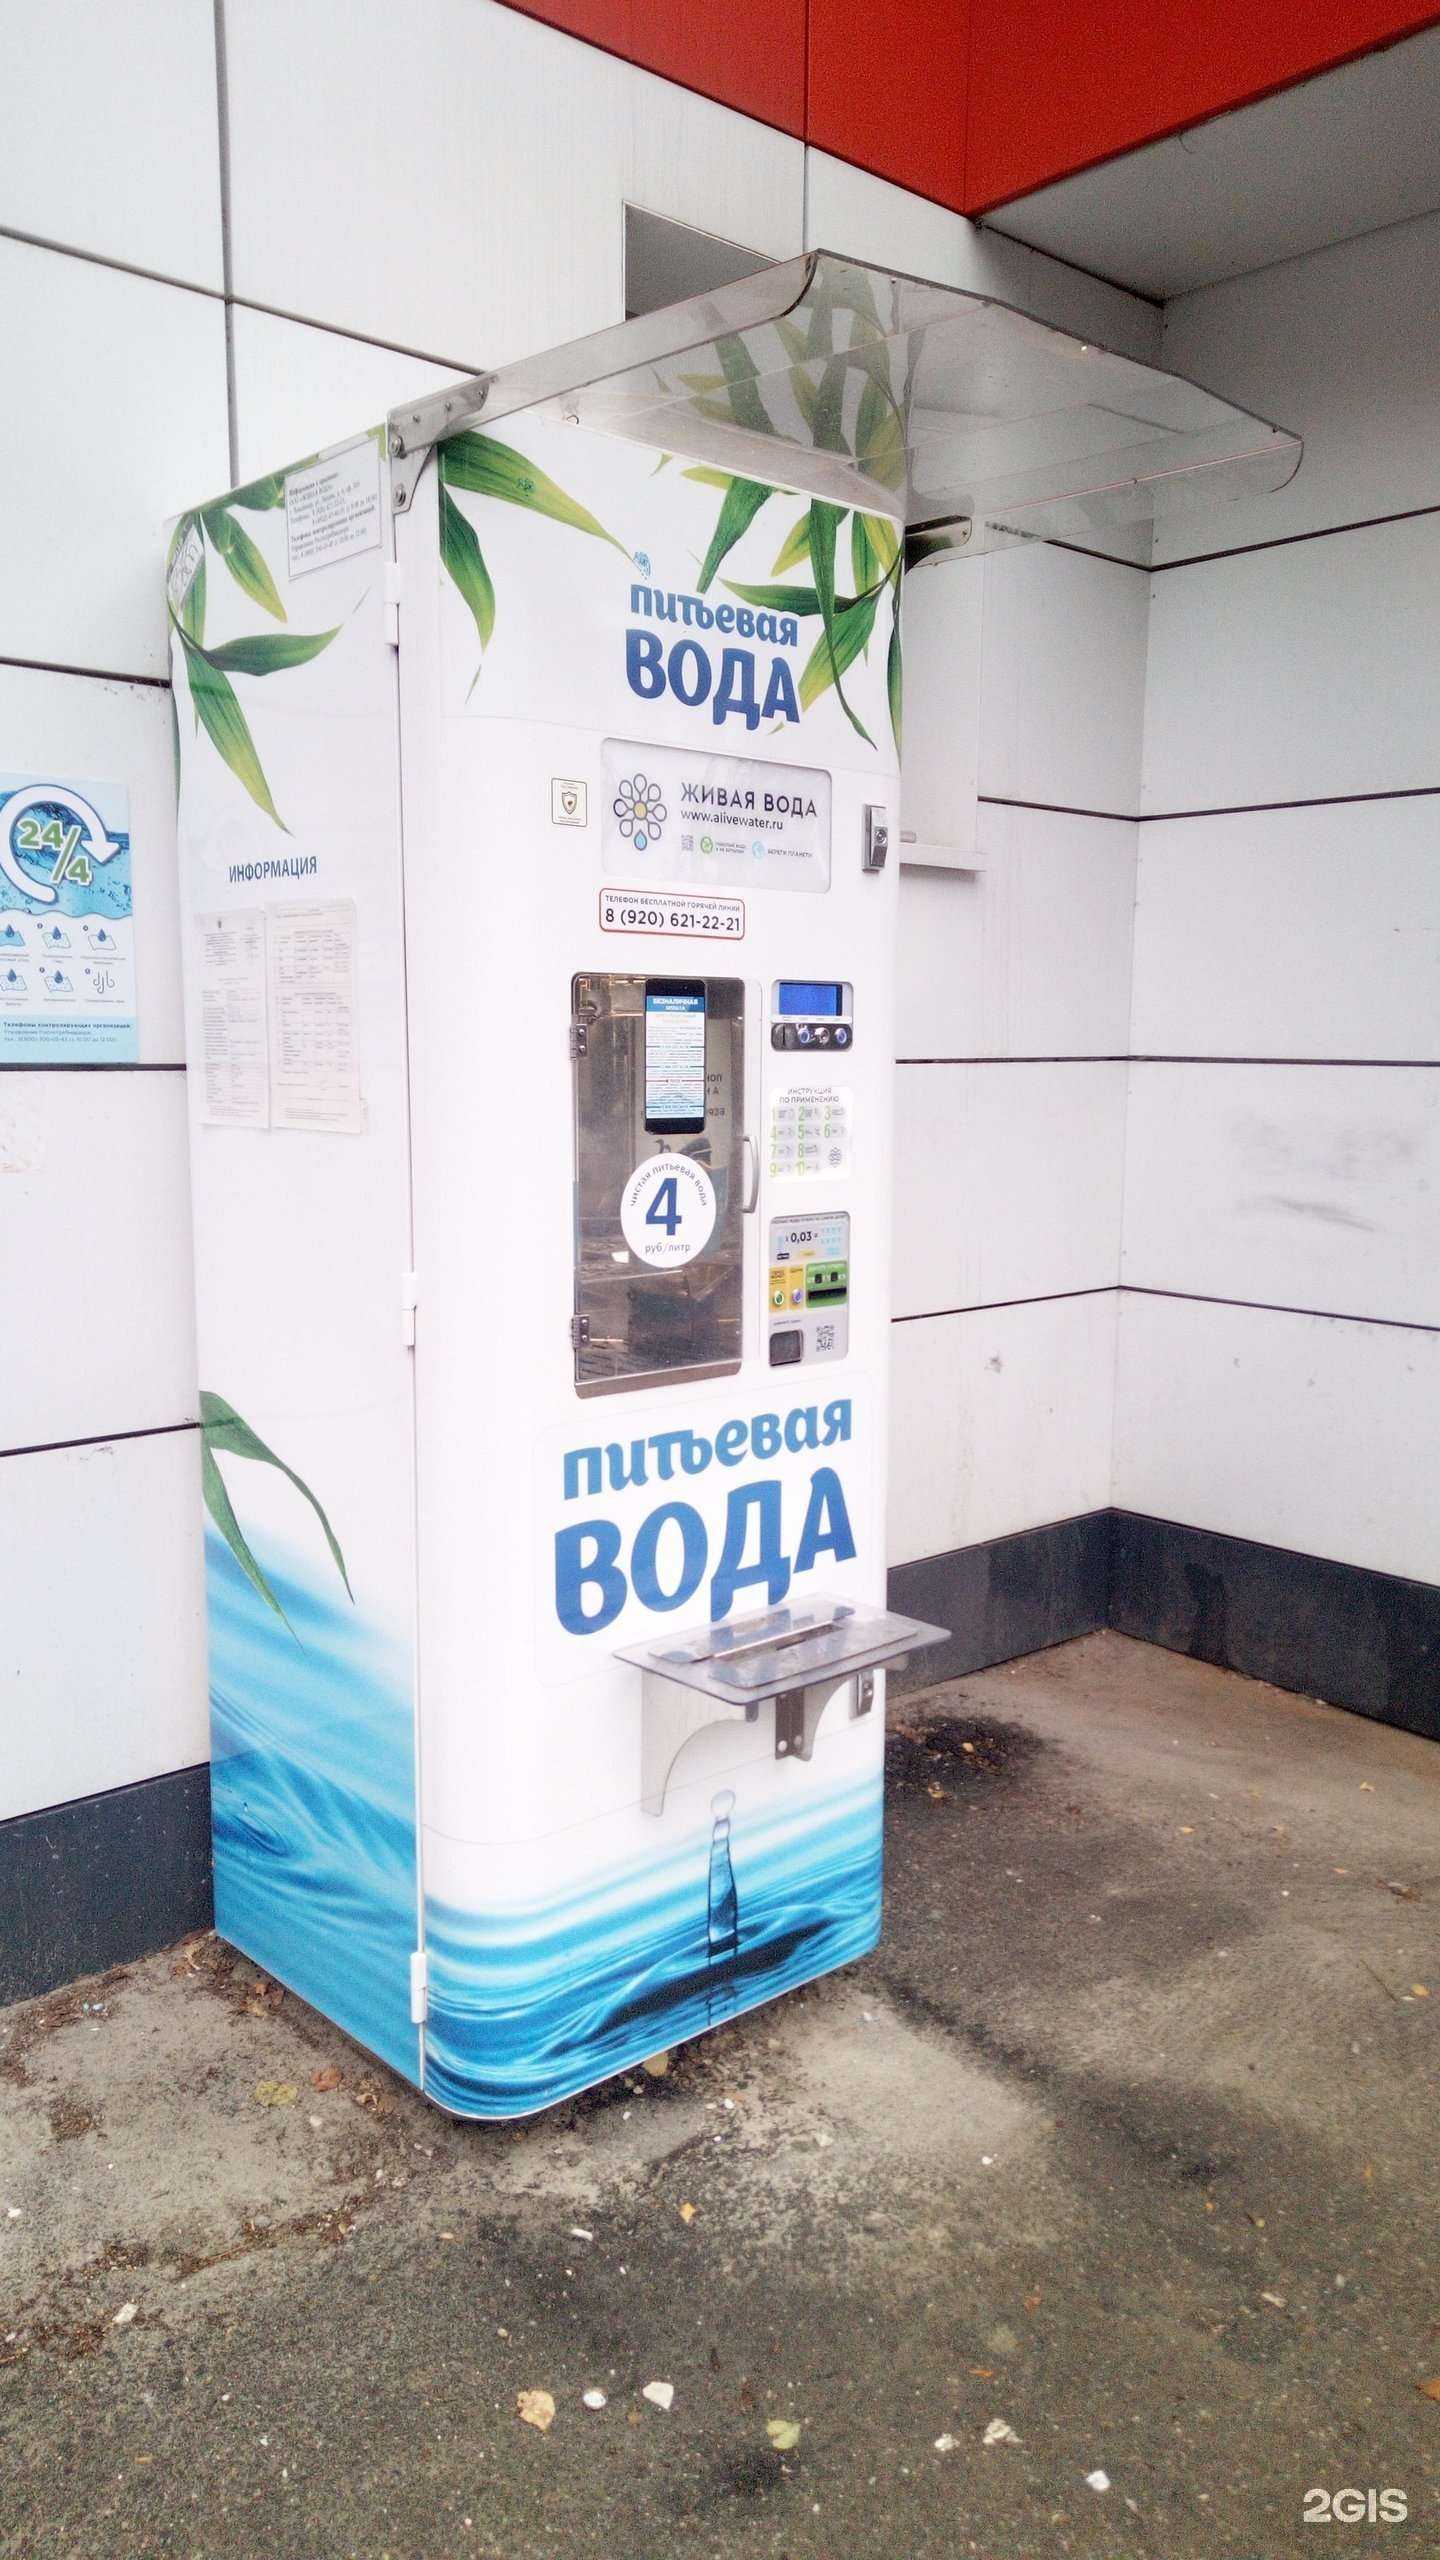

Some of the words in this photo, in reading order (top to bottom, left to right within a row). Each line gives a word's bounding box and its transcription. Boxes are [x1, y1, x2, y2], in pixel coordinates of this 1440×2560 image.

[630, 584, 798, 647] питьевая
[626, 629, 800, 730] ВОДА
[681, 782, 755, 810] ЖИВАЯ
[764, 793, 818, 819] ВОДА
[681, 810, 783, 830] www.alivewater.ru
[229, 856, 317, 883] ИНФОРМАЦИЯ
[605, 894, 639, 904] ТЕЛЕФОН
[640, 898, 686, 908] БЕСПЛАТНОЙ
[687, 902, 717, 911] ГОРЯЧЕЙ
[605, 908, 615, 923] 8
[620, 909, 665, 928] (920)
[670, 913, 740, 931] 621-22-21
[787, 1087, 832, 1095] ИНСТРУКЦИЯ
[652, 1164, 696, 1180] питьевая
[645, 1177, 682, 1236] 4
[645, 1242, 691, 1254] руб/литр
[790, 1231, 812, 1243] 0,03
[564, 1398, 852, 1500] питьевая
[554, 1467, 857, 1635] ВОДА
